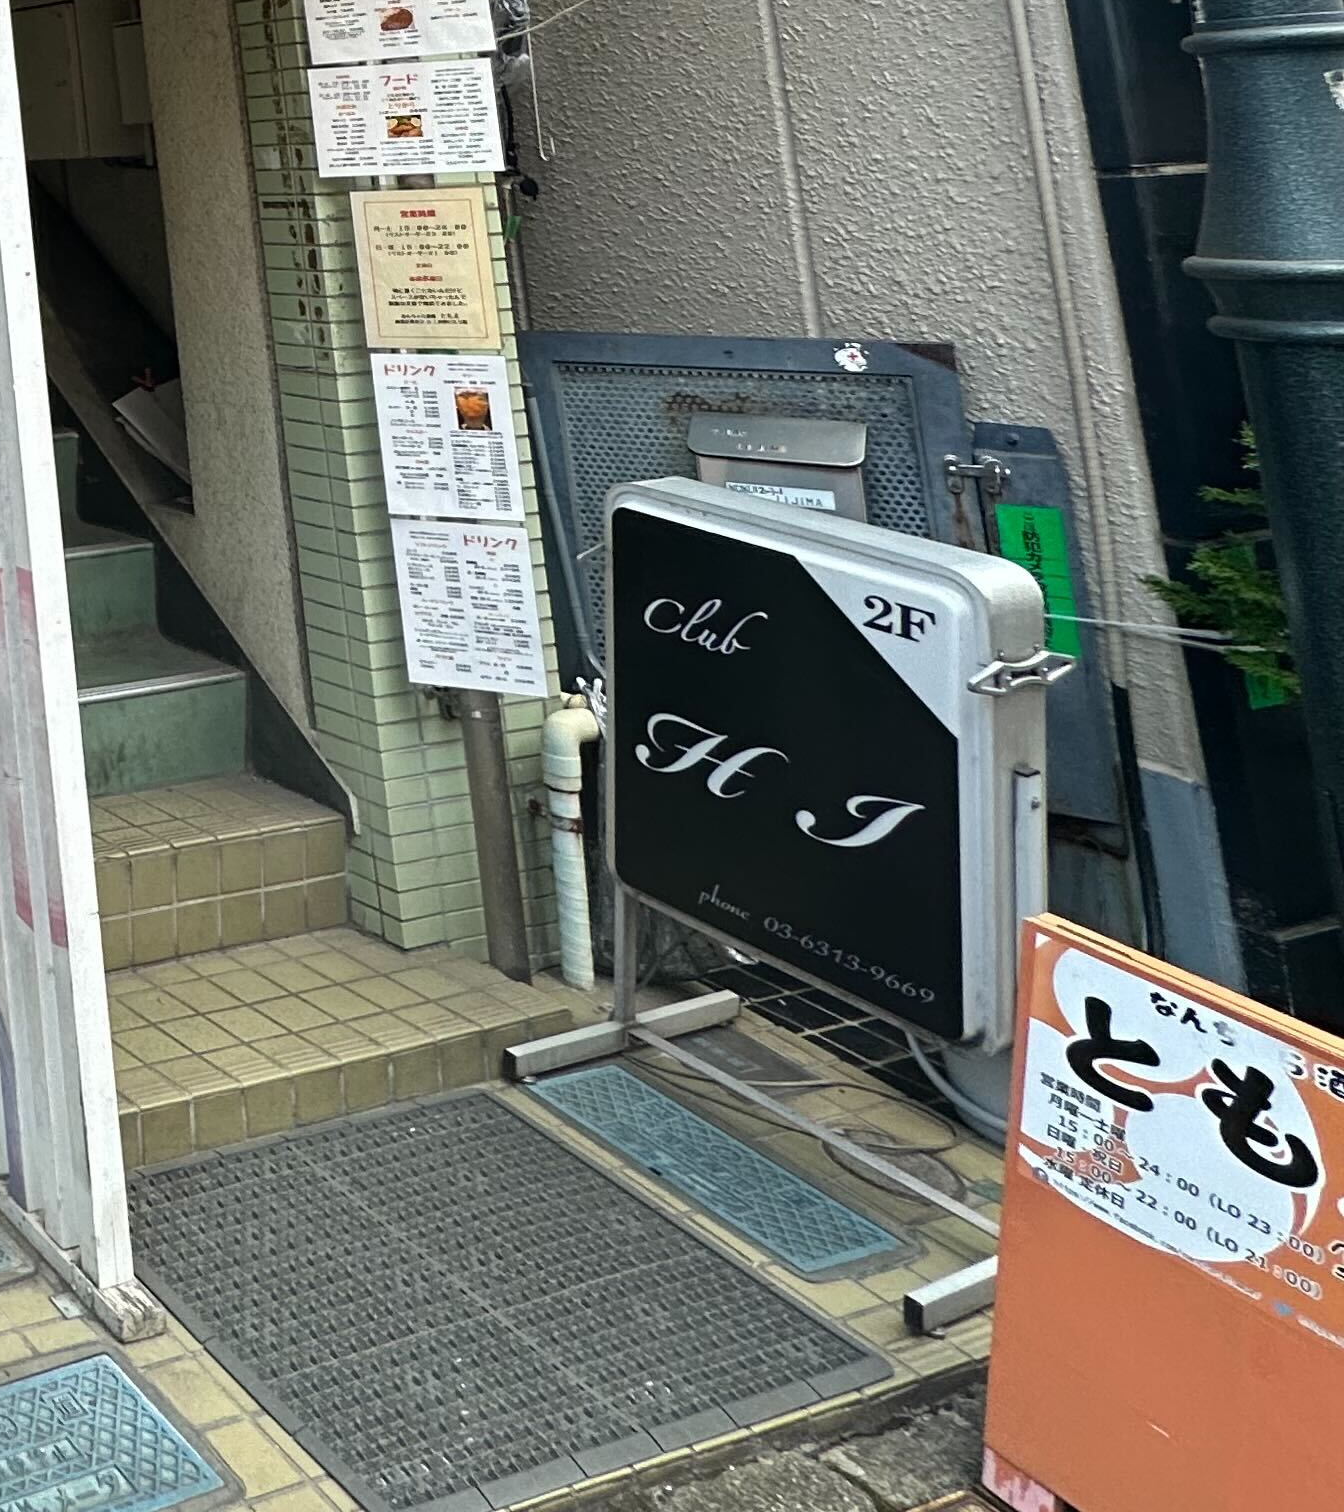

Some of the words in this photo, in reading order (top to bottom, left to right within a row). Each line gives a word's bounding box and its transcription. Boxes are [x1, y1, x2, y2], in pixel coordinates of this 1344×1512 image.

[379, 73, 419, 87] フード
[383, 363, 436, 376] ドリンク
[463, 534, 518, 550] ドリンク
[643, 596, 768, 656] Club
[863, 595, 936, 644] 2F
[698, 884, 751, 922] phone
[763, 915, 936, 1004] 03-6313-9669
[1040, 1072, 1102, 1113] 営業時間
